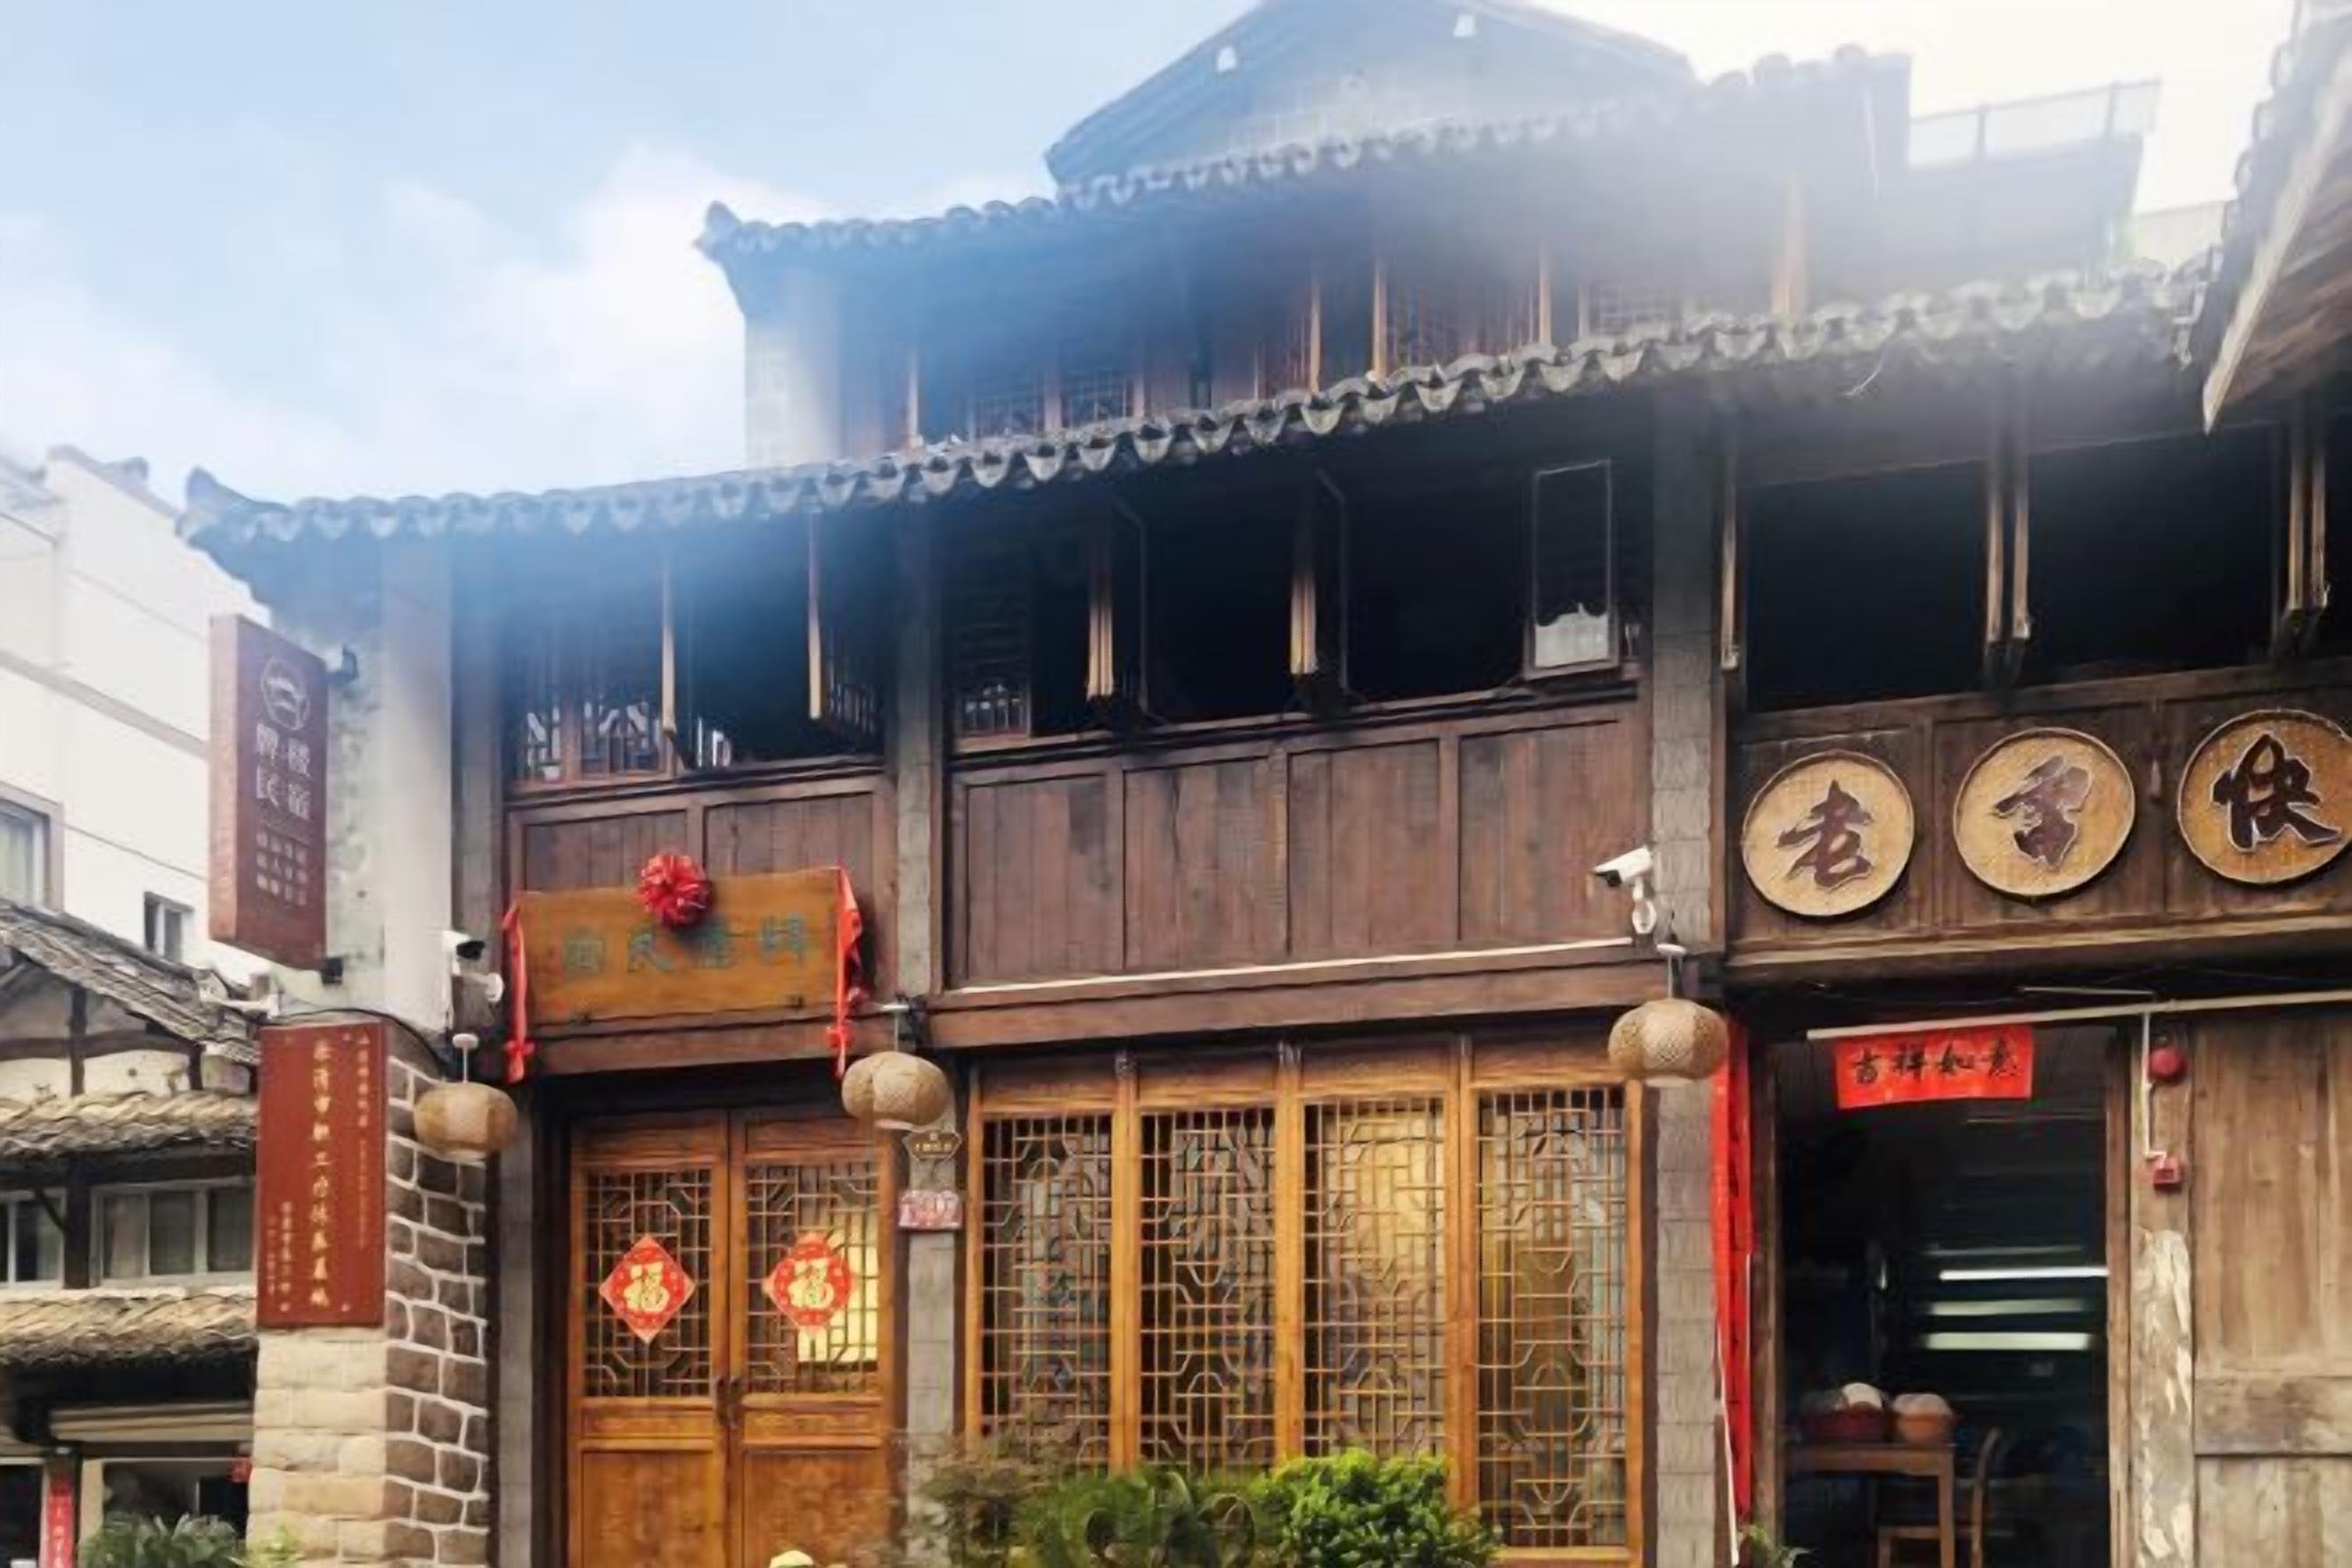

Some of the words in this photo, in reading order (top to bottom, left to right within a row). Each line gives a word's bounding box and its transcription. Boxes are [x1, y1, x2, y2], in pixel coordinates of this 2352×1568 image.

[1853, 1037, 2021, 1084] 吉祥如意
[624, 1262, 670, 1312] 福
[788, 1258, 835, 1309] 福
